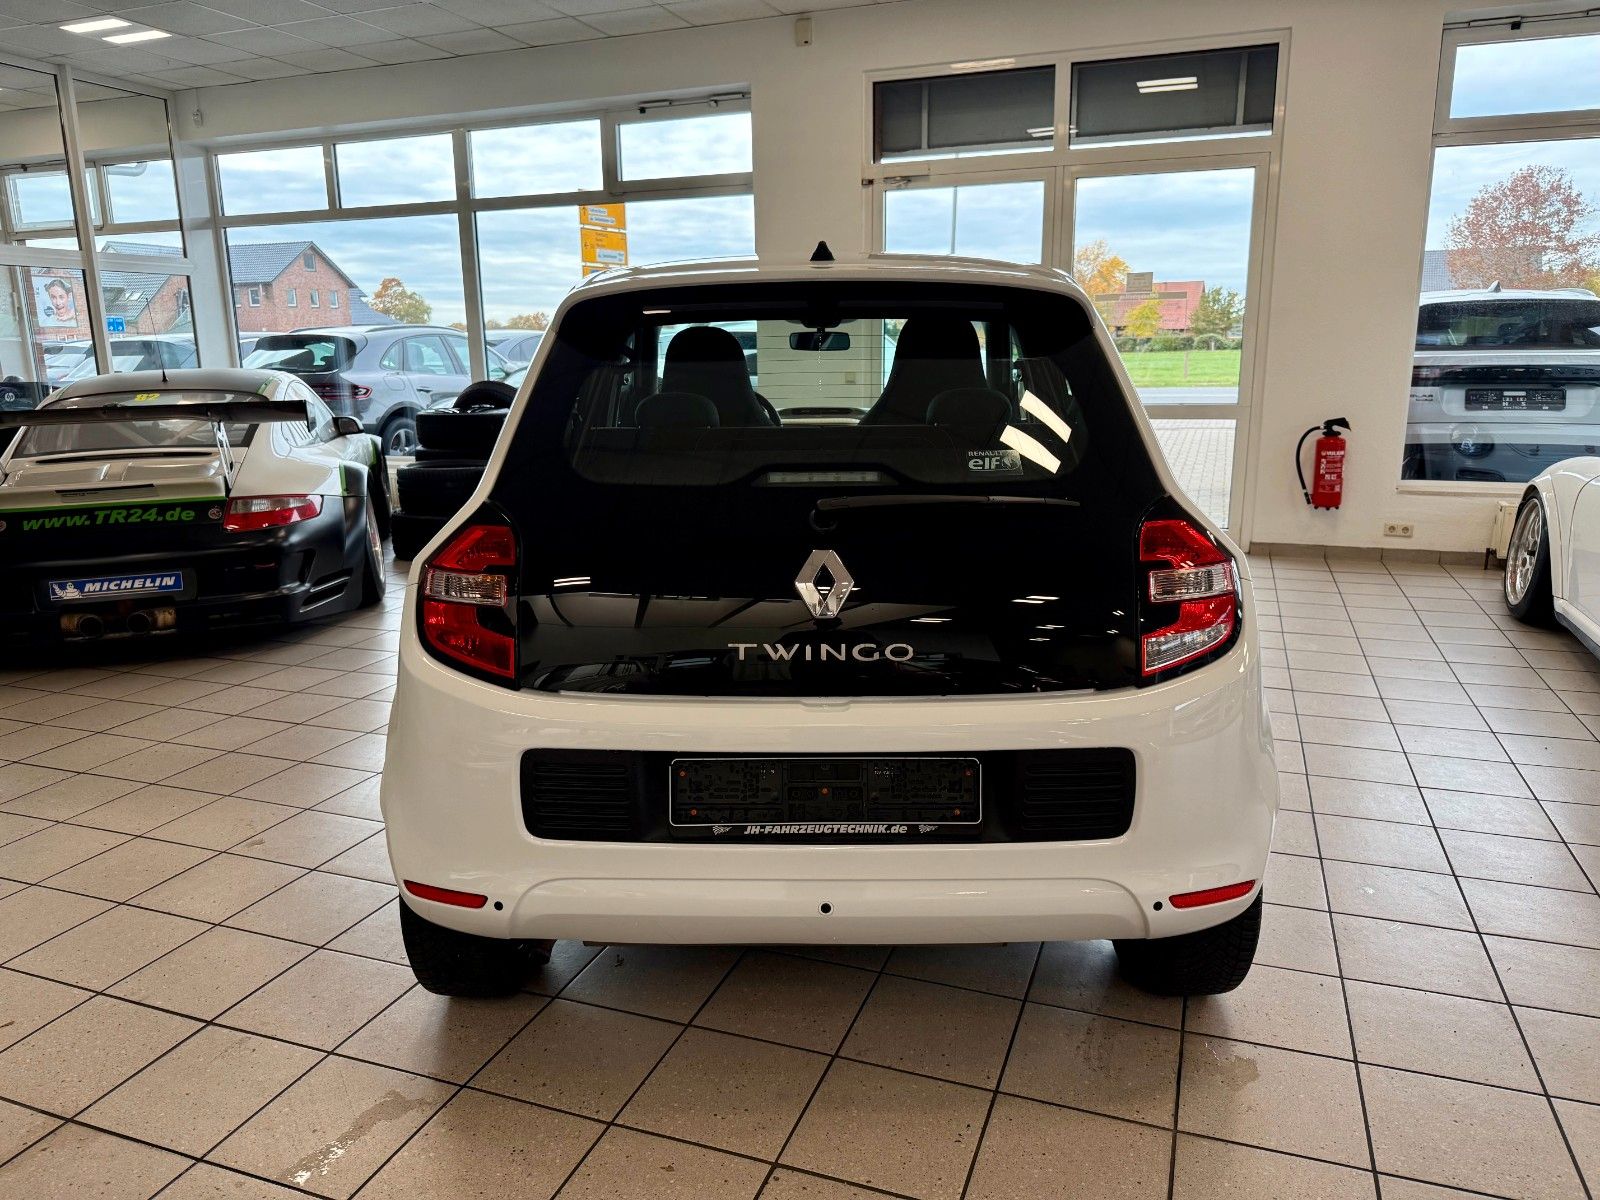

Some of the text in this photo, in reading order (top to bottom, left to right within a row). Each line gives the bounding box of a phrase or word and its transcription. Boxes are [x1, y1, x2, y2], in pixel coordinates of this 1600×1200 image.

[968, 456, 1000, 470] elf
[22, 507, 196, 531] www.TR24.de
[83, 575, 176, 593] MICHELIN
[727, 643, 914, 662] TWINGO
[743, 824, 908, 835] JH-FAHRZEUGTECHNIK.de
